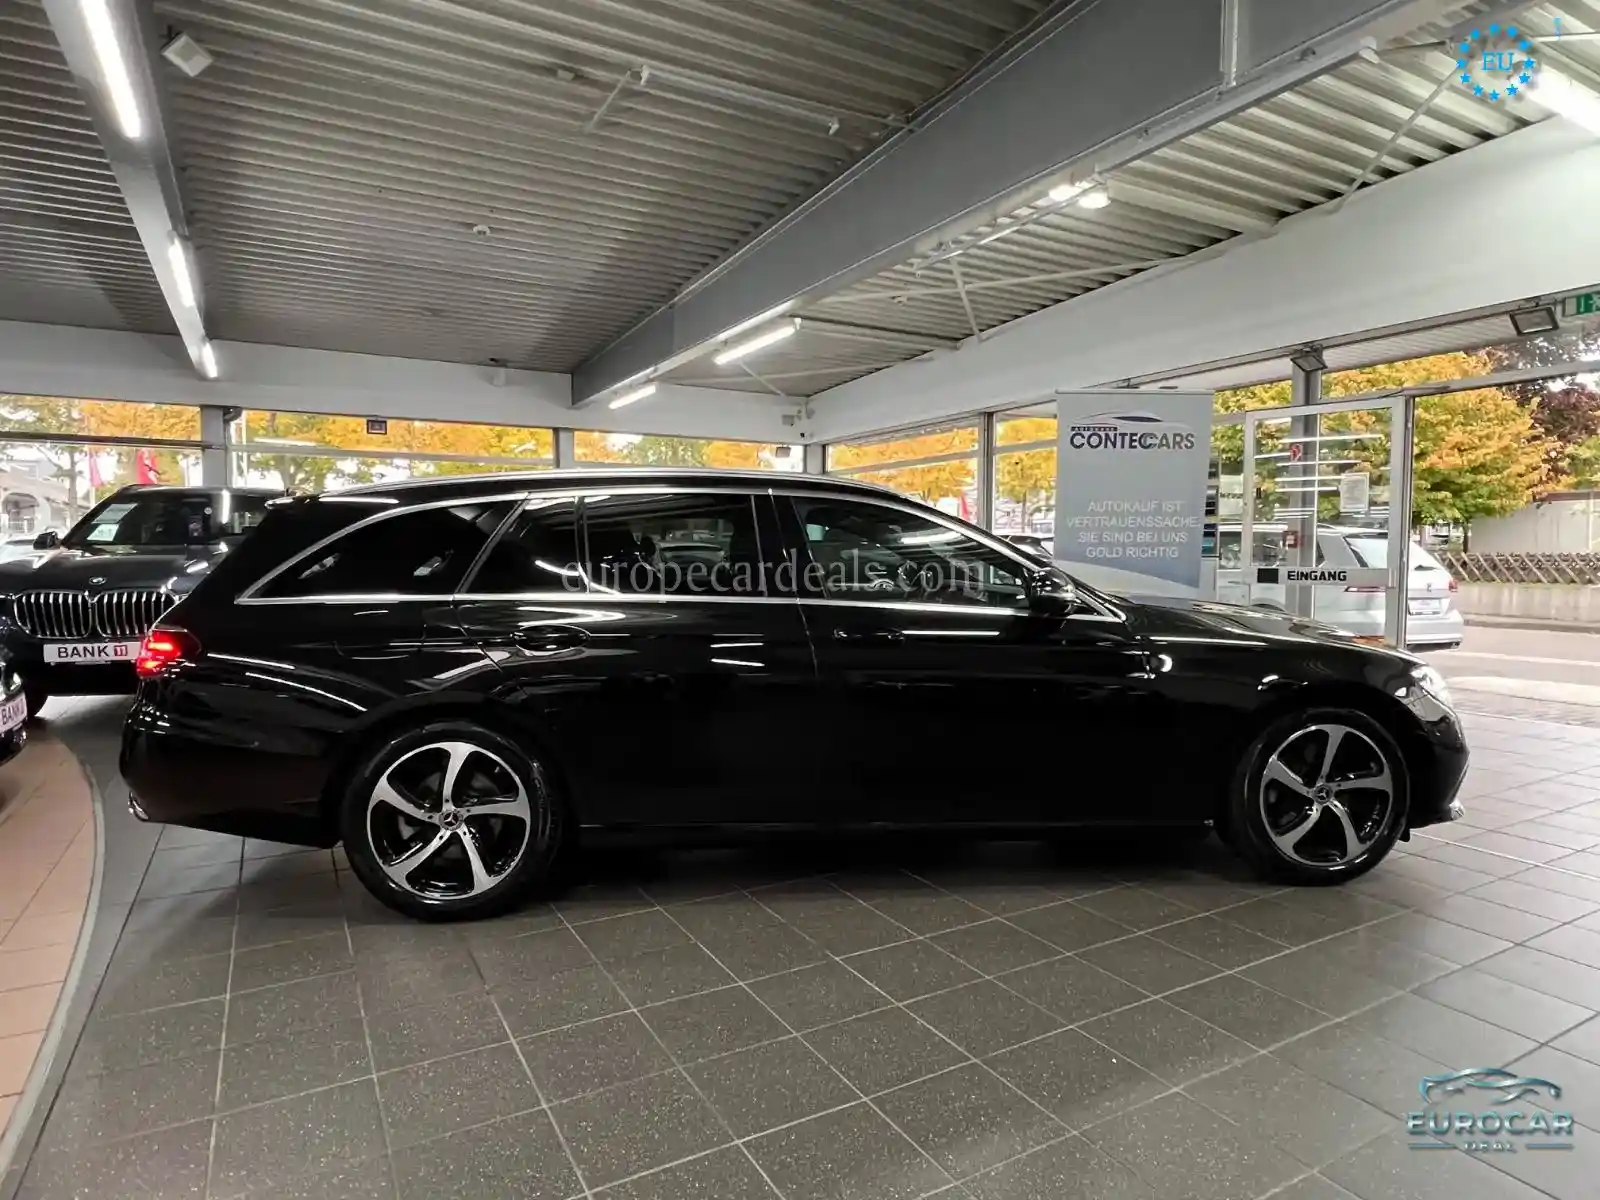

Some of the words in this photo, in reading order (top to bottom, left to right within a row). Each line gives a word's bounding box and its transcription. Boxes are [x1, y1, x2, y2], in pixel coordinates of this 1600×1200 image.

[1087, 500, 1159, 512] AUTOKAUF
[1161, 500, 1186, 512] IST
[1079, 531, 1099, 543] SIE
[1102, 531, 1133, 543] SIND
[1136, 531, 1158, 543] BEI
[1160, 532, 1188, 543] UNS
[1086, 546, 1122, 558] GOLD
[1125, 546, 1179, 558] RICHTIG
[1287, 570, 1347, 581] EINGANG
[57, 645, 110, 659] BANK
